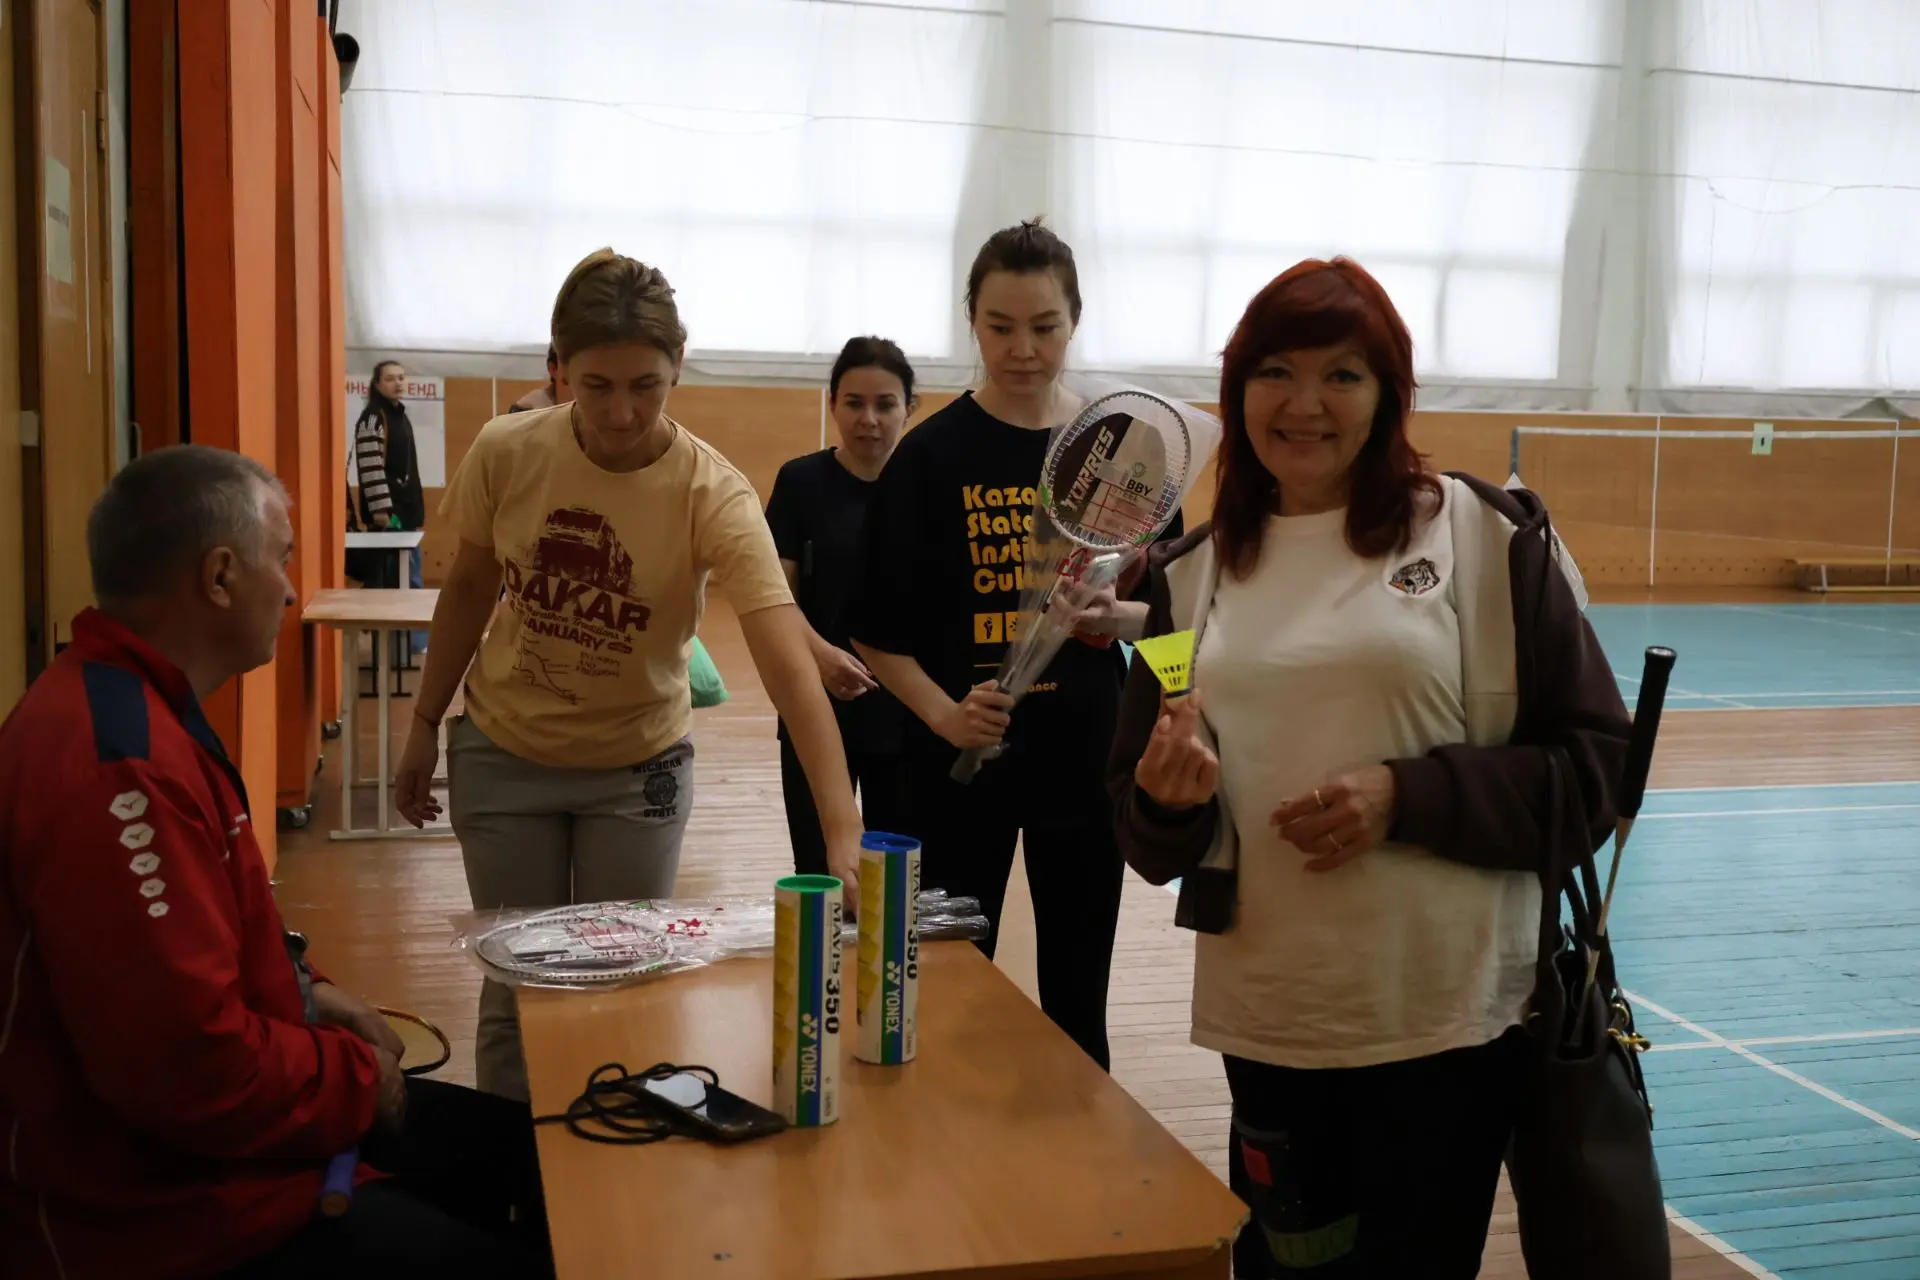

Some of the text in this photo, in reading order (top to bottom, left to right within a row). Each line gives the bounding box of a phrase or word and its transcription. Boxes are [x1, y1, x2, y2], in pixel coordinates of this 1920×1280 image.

[962, 484, 1037, 510] Kaza
[1127, 479, 1154, 496] BBY
[504, 555, 652, 632] DAKAR
[825, 902, 841, 1034] MAVIS 350
[906, 928, 918, 980] 350
[885, 987, 900, 1034] YONEX
[800, 1043, 818, 1093] YONEX
